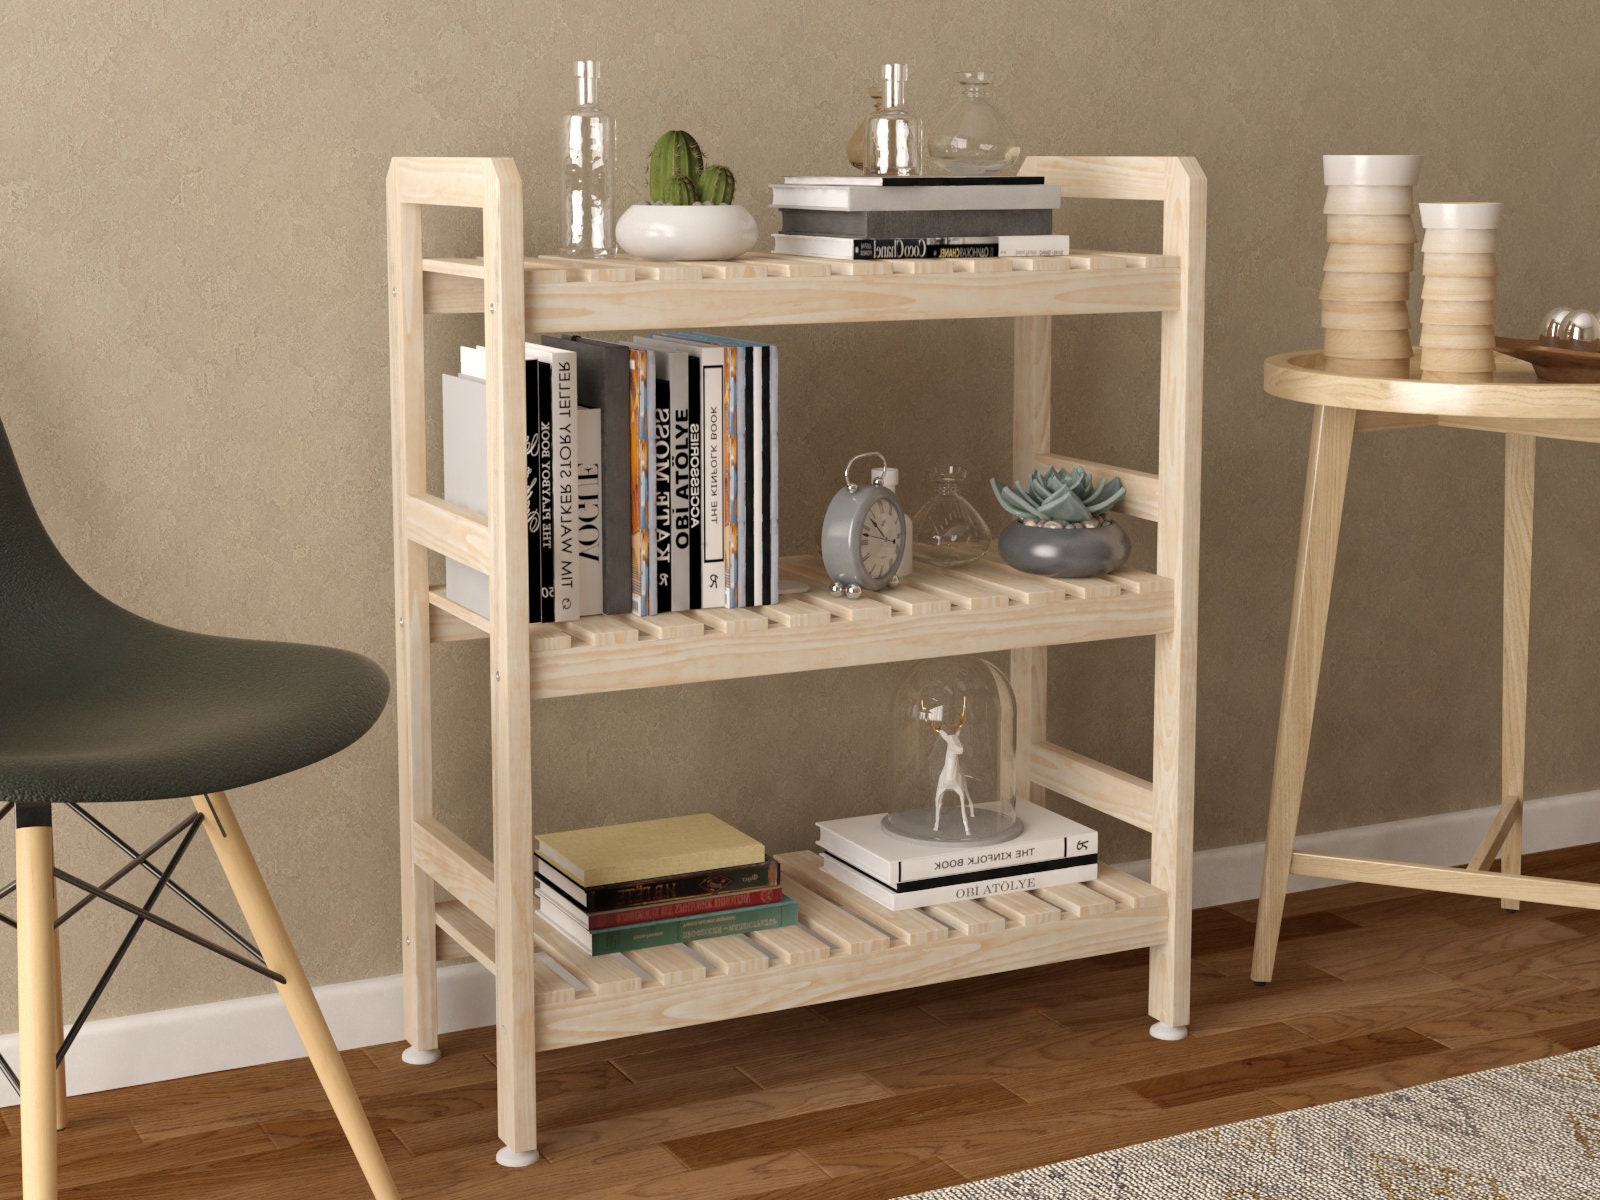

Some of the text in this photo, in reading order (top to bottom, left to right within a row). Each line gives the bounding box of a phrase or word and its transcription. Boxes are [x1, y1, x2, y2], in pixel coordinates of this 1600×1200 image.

[671, 409, 689, 549] OBİ ATÖLYE
[956, 877, 1036, 899] OBİ ATÖLYE
